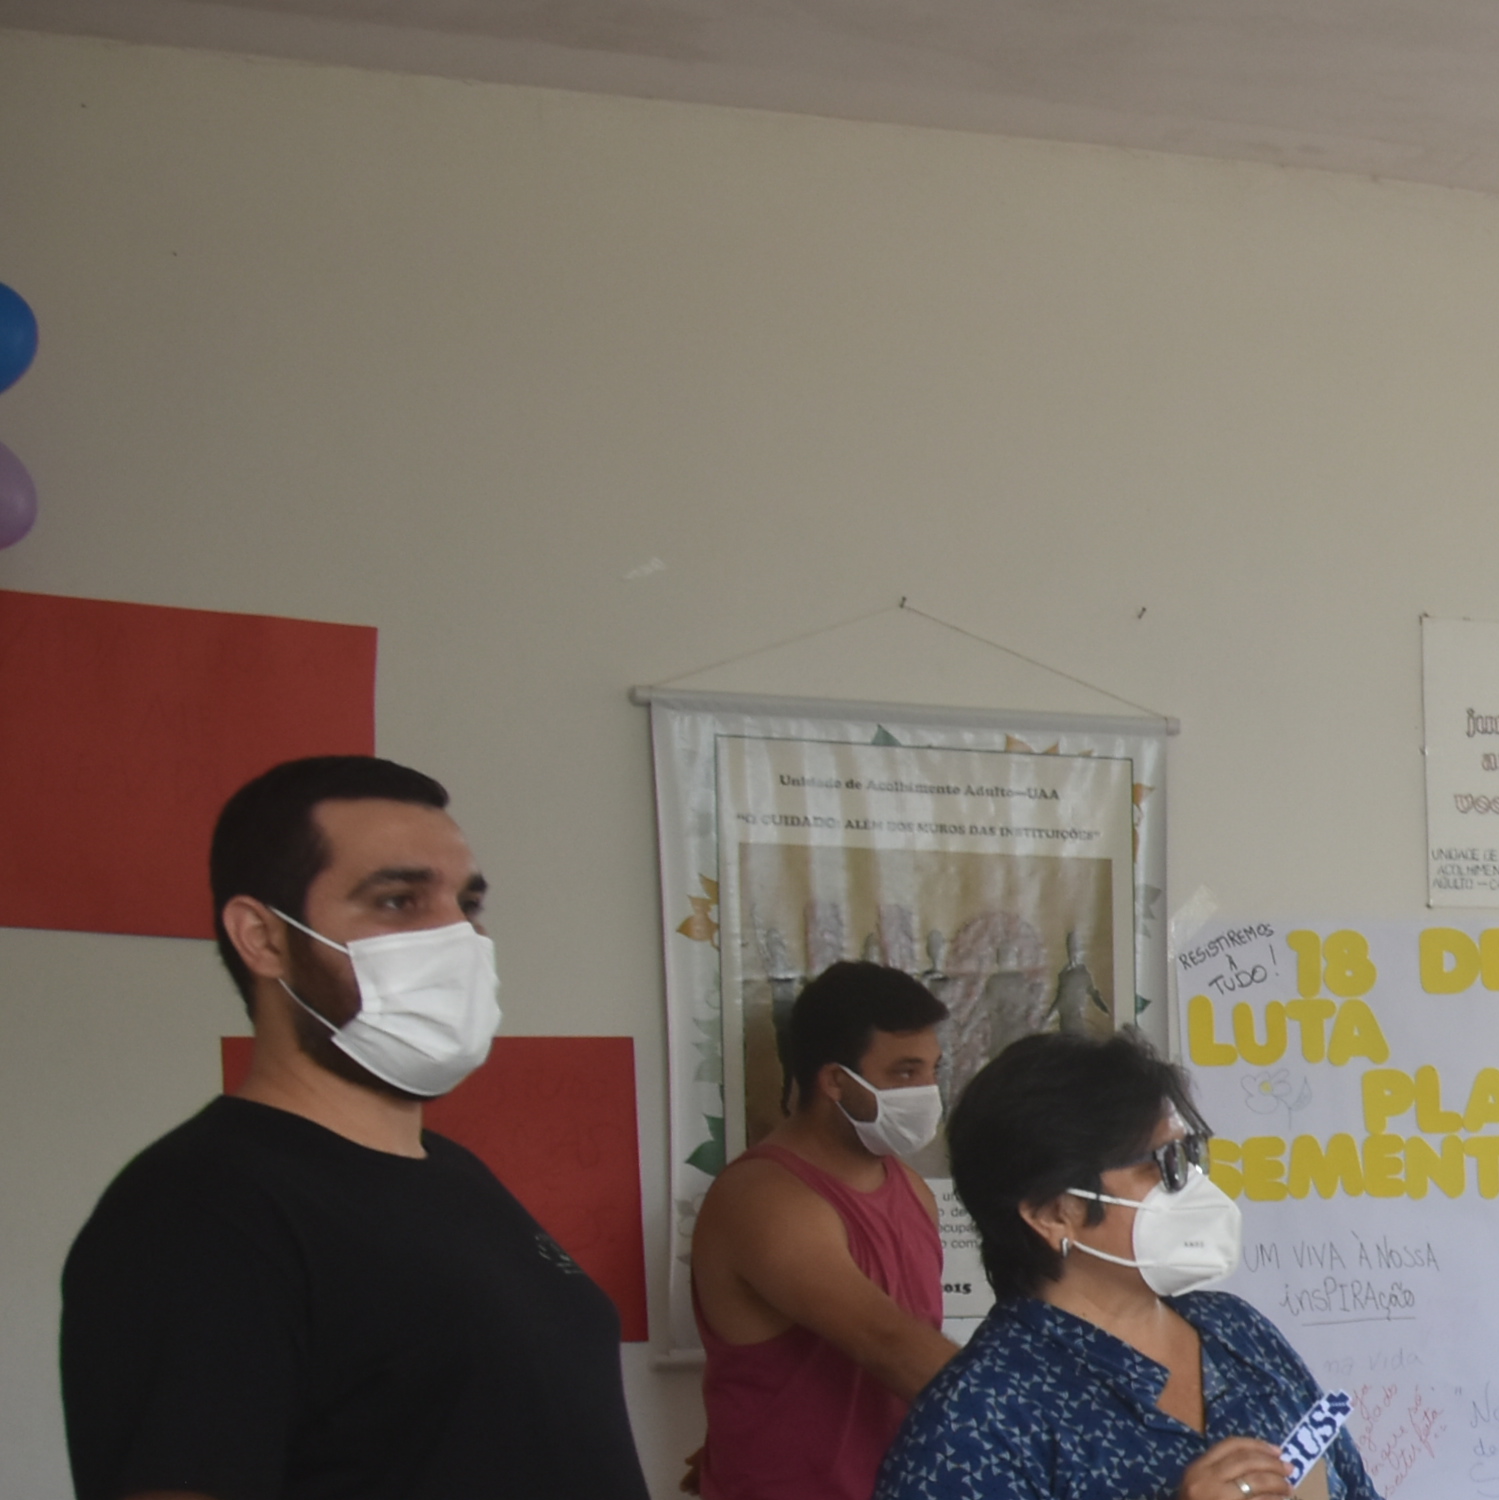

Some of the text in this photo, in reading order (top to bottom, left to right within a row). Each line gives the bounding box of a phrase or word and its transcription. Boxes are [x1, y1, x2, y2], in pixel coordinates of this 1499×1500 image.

[780, 774, 841, 790] Unidade
[846, 778, 862, 790] de
[887, 821, 914, 835] DOS
[917, 822, 965, 837] MUROS
[970, 825, 995, 838] DAS
[1484, 849, 1498, 862] DE
[1179, 922, 1275, 971] RESISTIREMOS
[1286, 929, 1377, 998] 18
[1188, 995, 1390, 1067] LUTA
[1241, 1241, 1281, 1273] UM
[1294, 1240, 1346, 1270] VIVA
[1473, 1436, 1498, 1457] de
